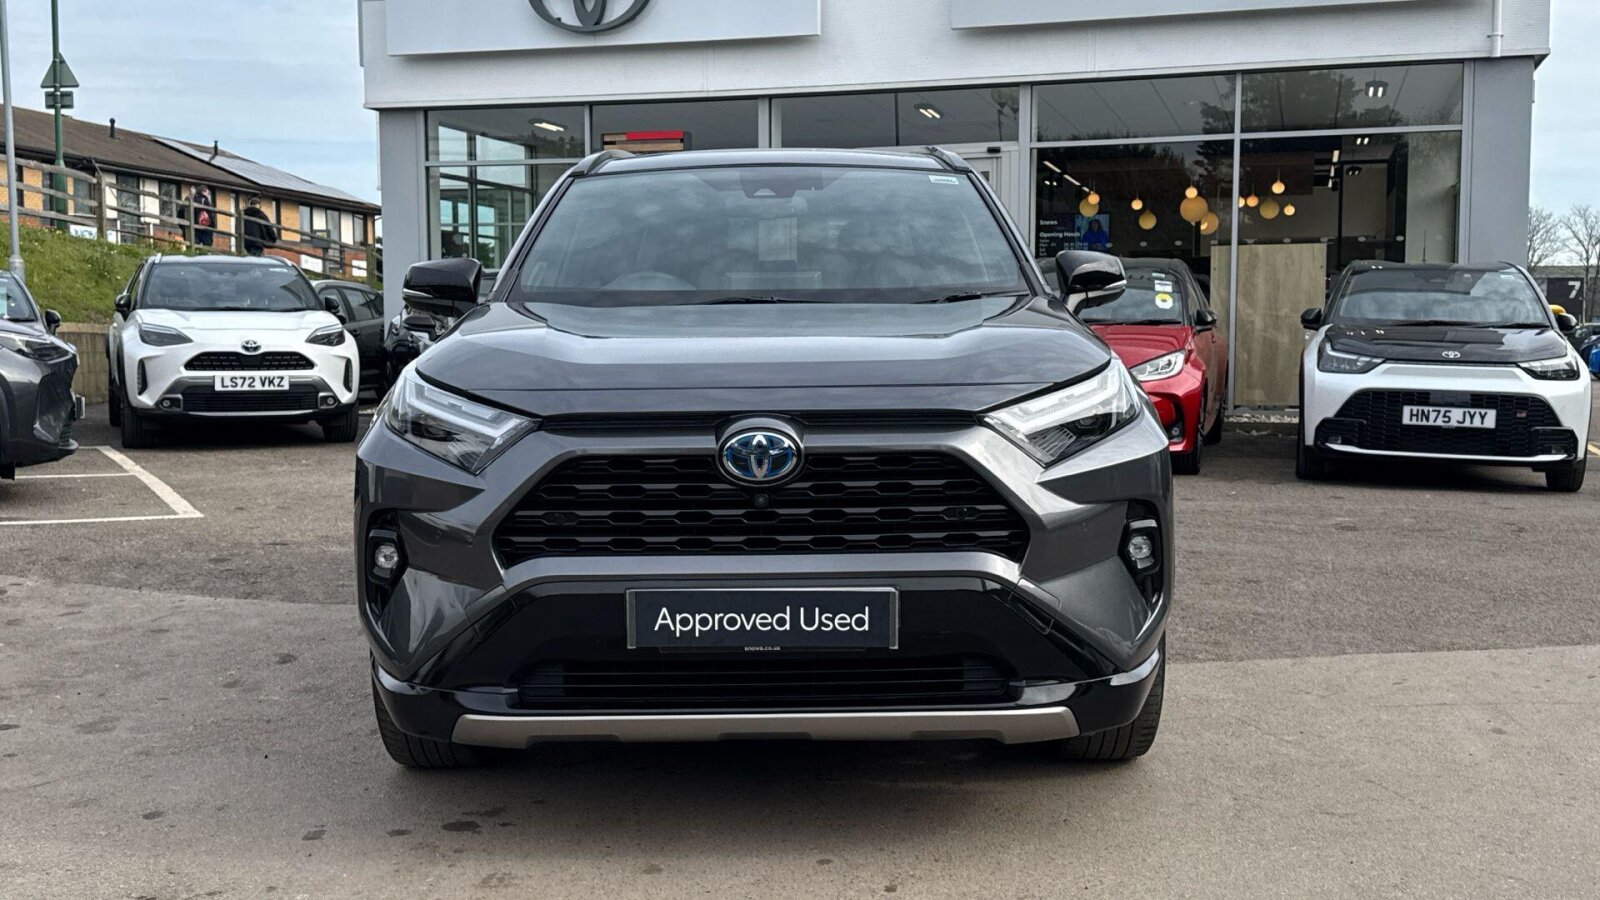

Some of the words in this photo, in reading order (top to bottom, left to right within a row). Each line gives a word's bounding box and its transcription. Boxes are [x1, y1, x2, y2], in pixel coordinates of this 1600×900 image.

[1568, 280, 1581, 299] 7
[221, 376, 256, 388] LS72
[260, 376, 285, 388] VKZ
[1409, 408, 1452, 424] HN75
[1456, 410, 1488, 425] JYY
[654, 606, 791, 637] Approved
[799, 606, 870, 631] Used
